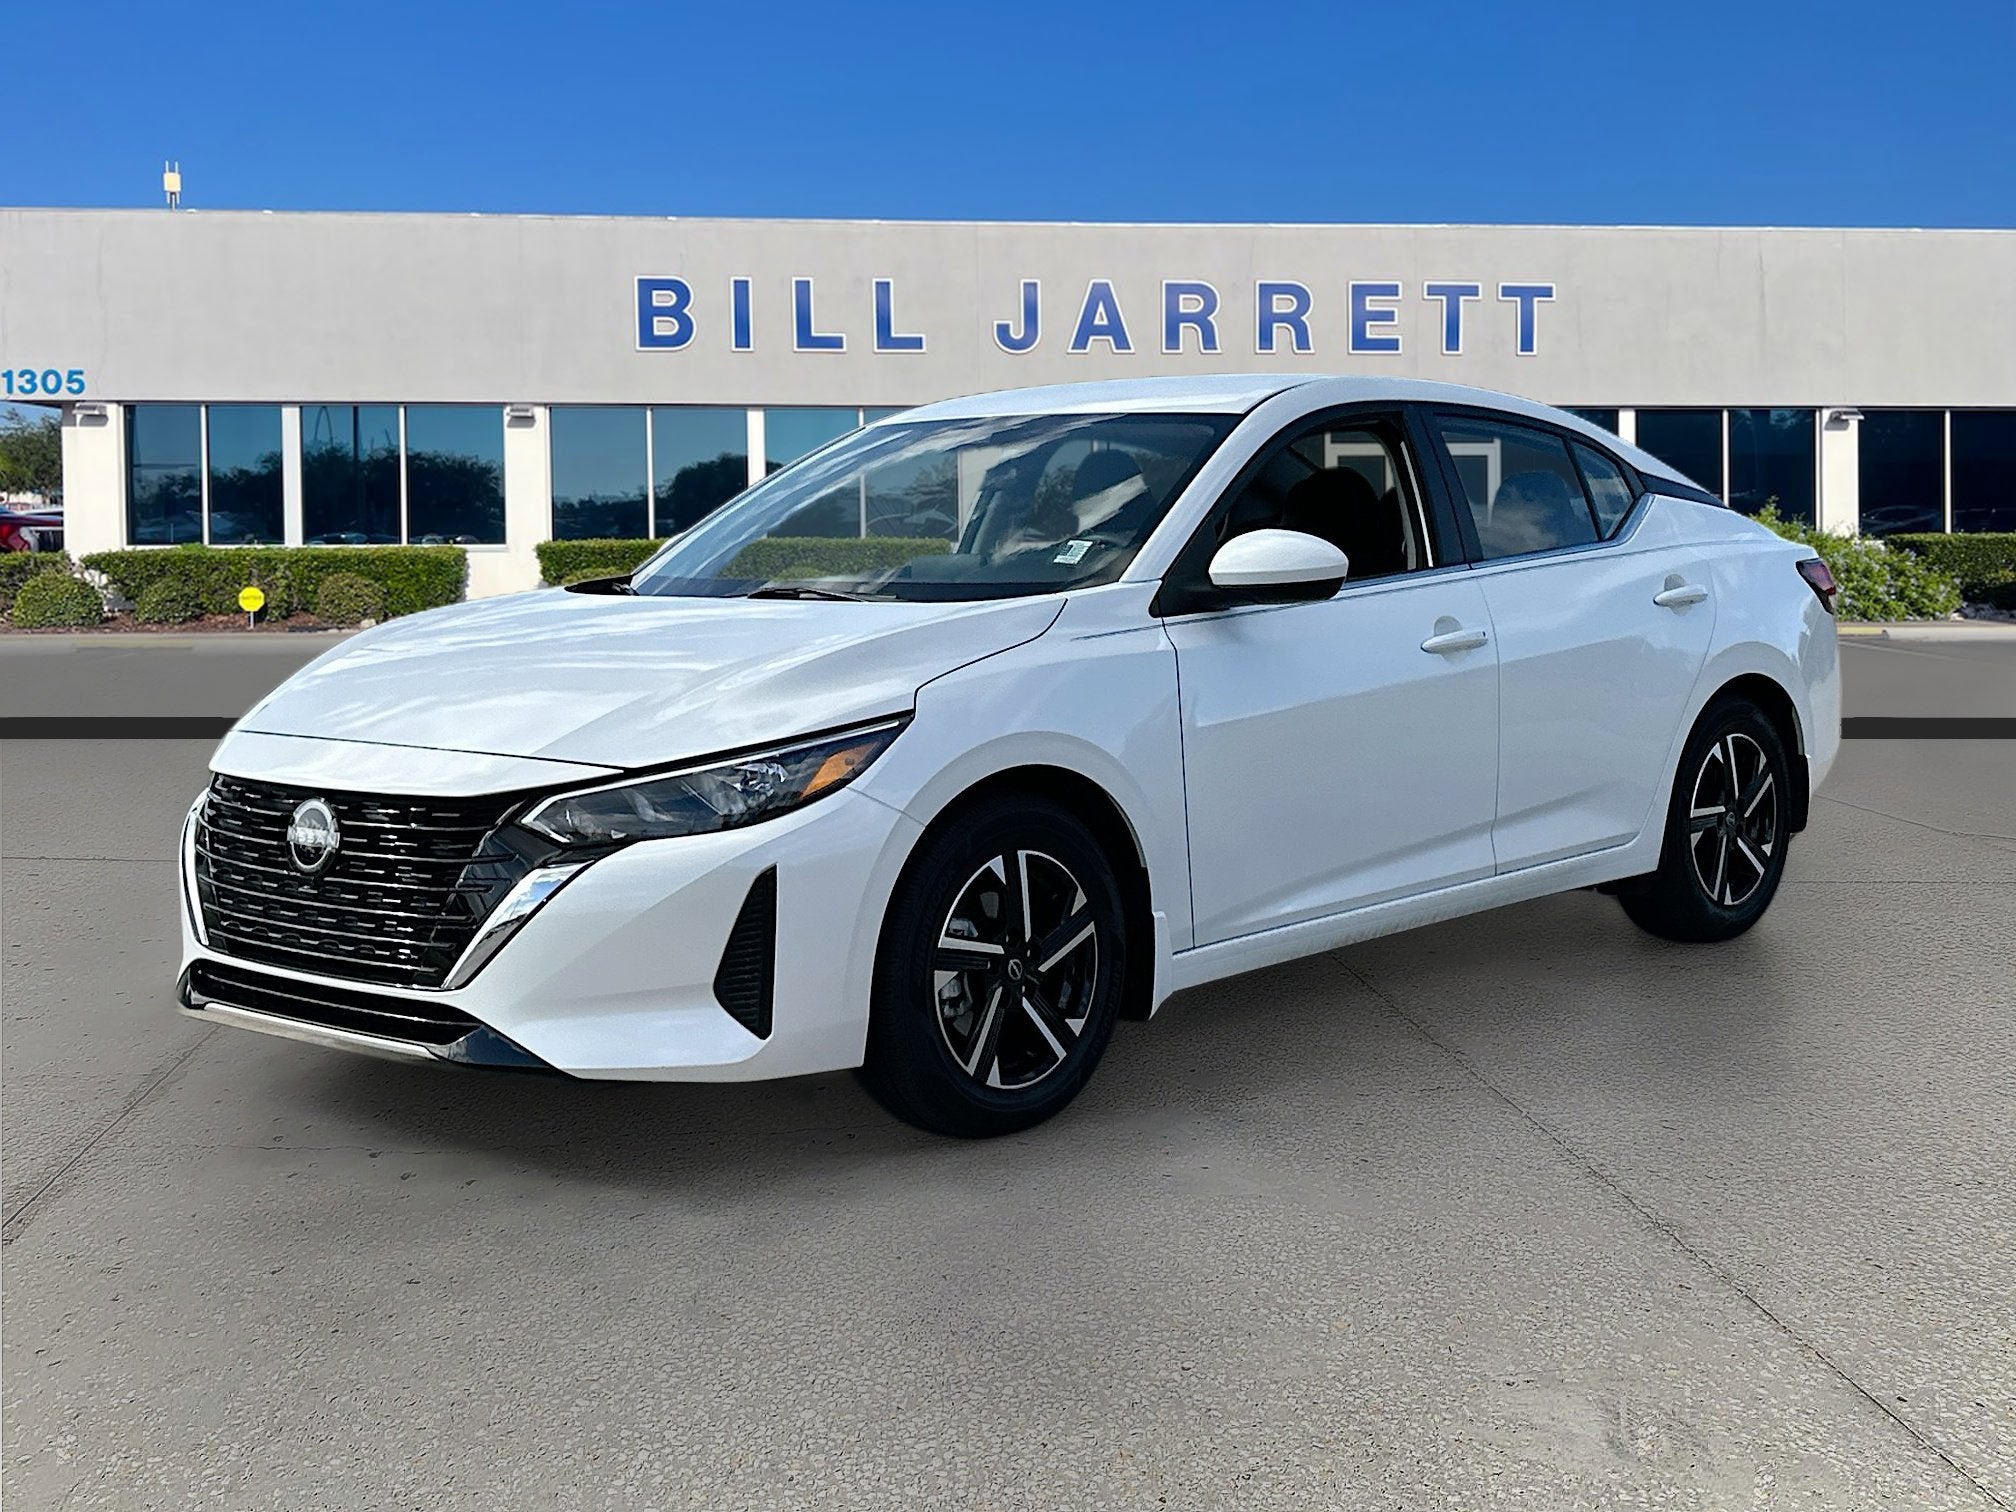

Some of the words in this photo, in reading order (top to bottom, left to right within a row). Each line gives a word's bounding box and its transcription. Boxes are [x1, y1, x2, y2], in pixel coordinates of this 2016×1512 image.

[634, 275, 927, 353] BILL
[993, 279, 1556, 356] JARRETT
[1, 368, 86, 395] 1305
